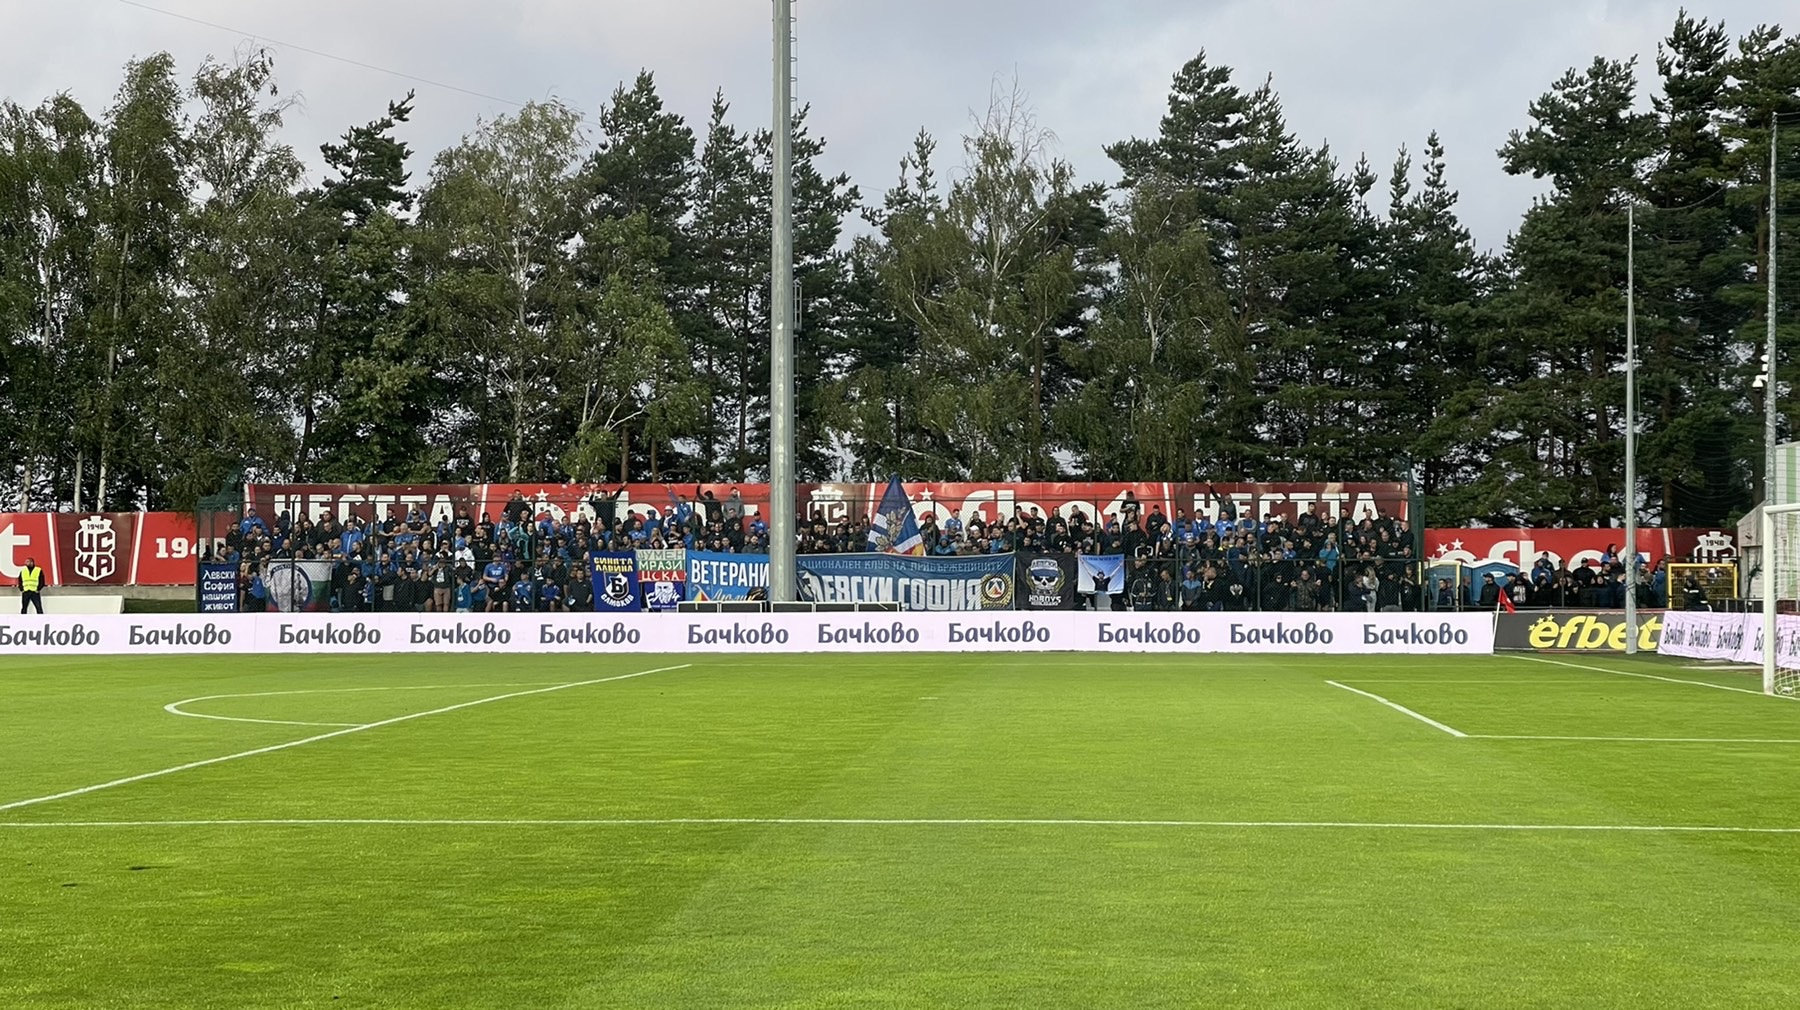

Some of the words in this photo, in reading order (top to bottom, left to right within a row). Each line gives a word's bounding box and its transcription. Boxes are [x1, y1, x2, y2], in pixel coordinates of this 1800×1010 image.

[638, 560, 683, 571] МРАЗИ
[641, 571, 680, 581] ЦСКА
[691, 559, 769, 587] ВЕТЕРАНИ
[798, 560, 861, 569] АЦИОНАЛЕН
[864, 560, 890, 570] КЛУБ
[203, 581, 235, 592] София
[898, 578, 983, 610] СОФИЯ
[0, 623, 98, 645] Бачково
[128, 623, 231, 645] Бачково
[279, 622, 380, 644] Бачково
[410, 622, 510, 644] Бачково
[539, 622, 640, 644] Бачково
[687, 622, 788, 644] Бачково
[818, 621, 919, 643] Бачково
[948, 621, 1050, 643] Бачково
[1098, 621, 1200, 643] Бачково
[1230, 622, 1333, 644] Бачково
[1363, 622, 1467, 644] Бачково
[1529, 616, 1662, 650] efbet
